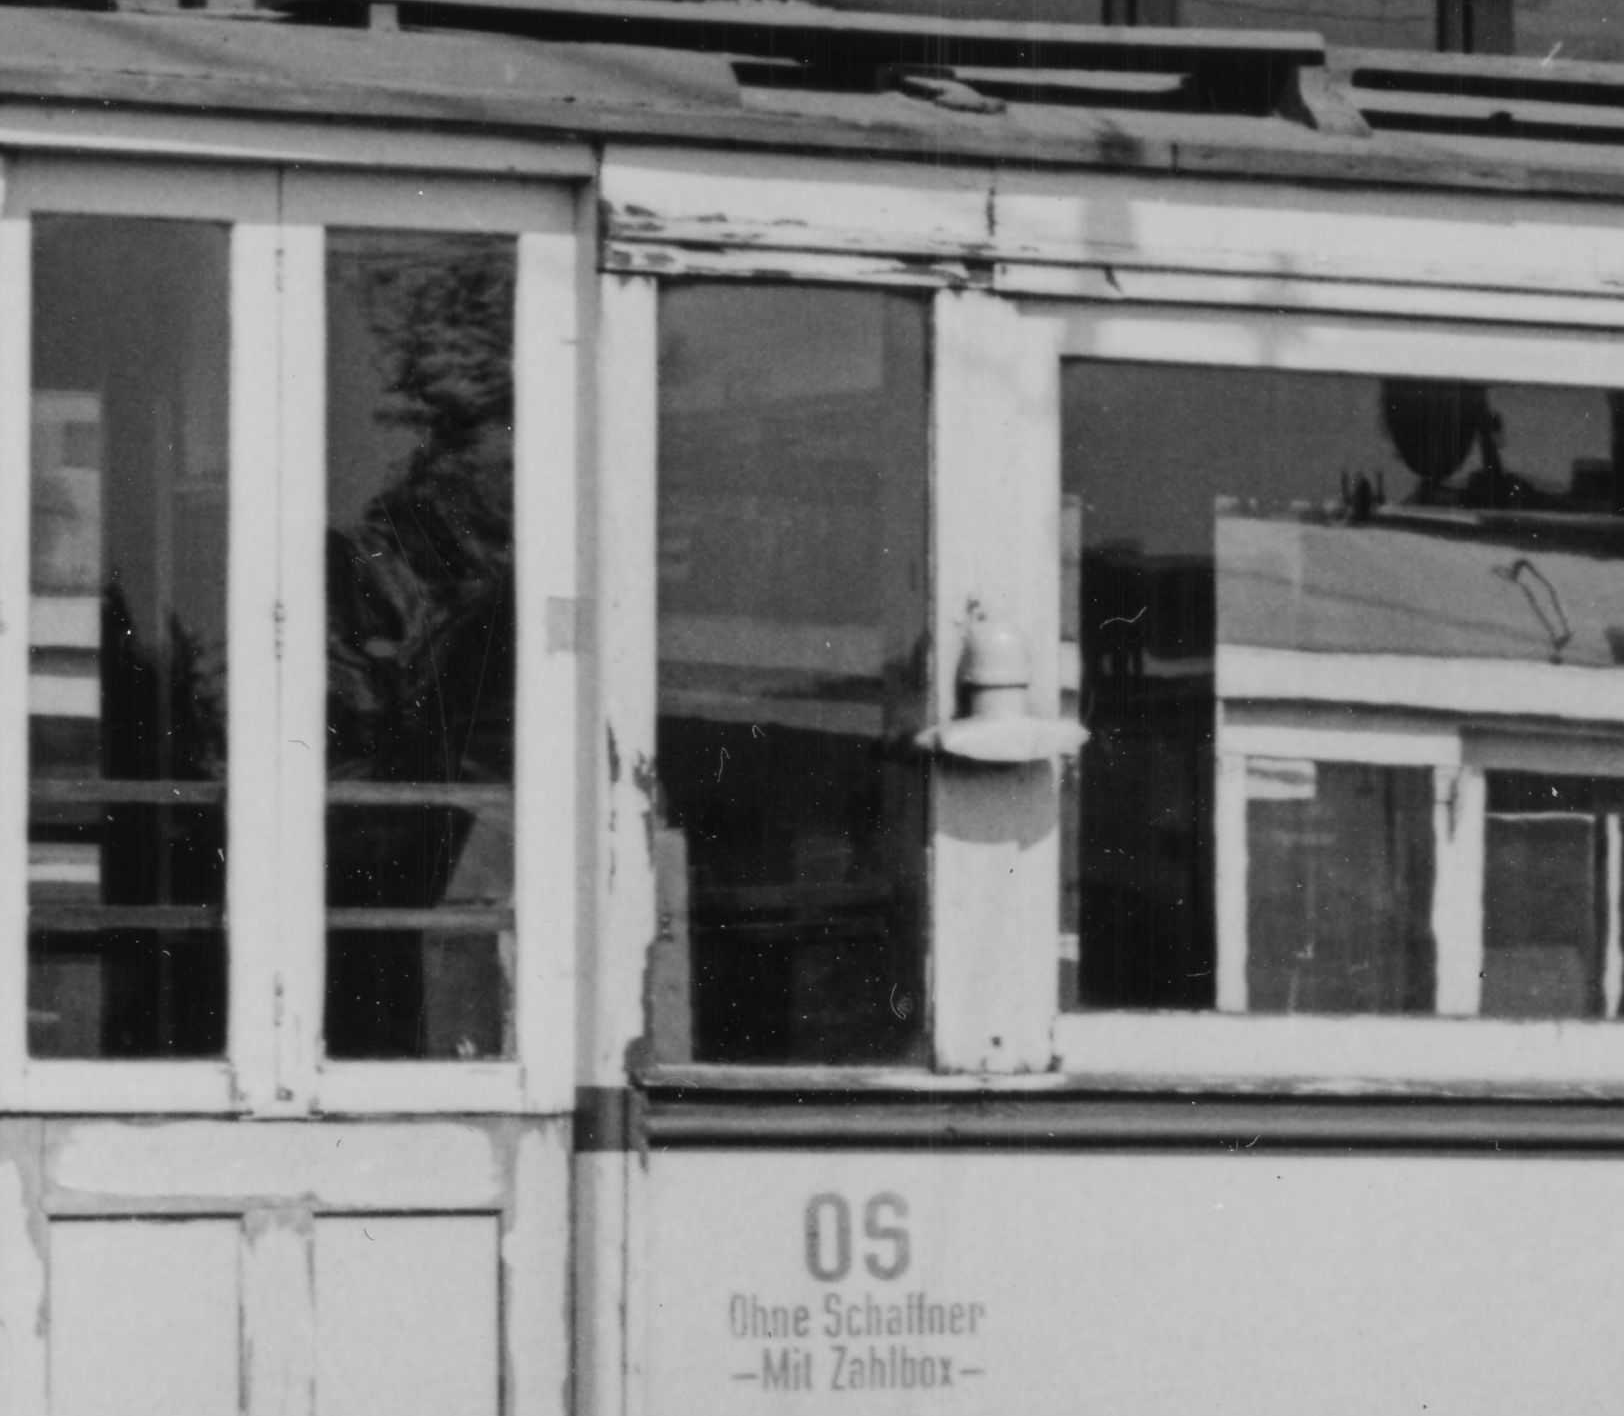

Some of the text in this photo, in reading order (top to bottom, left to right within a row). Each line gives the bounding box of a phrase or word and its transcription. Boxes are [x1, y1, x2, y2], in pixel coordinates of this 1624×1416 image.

[803, 1191, 912, 1283] OS
[728, 1290, 987, 1338] Ohne Schaffner
